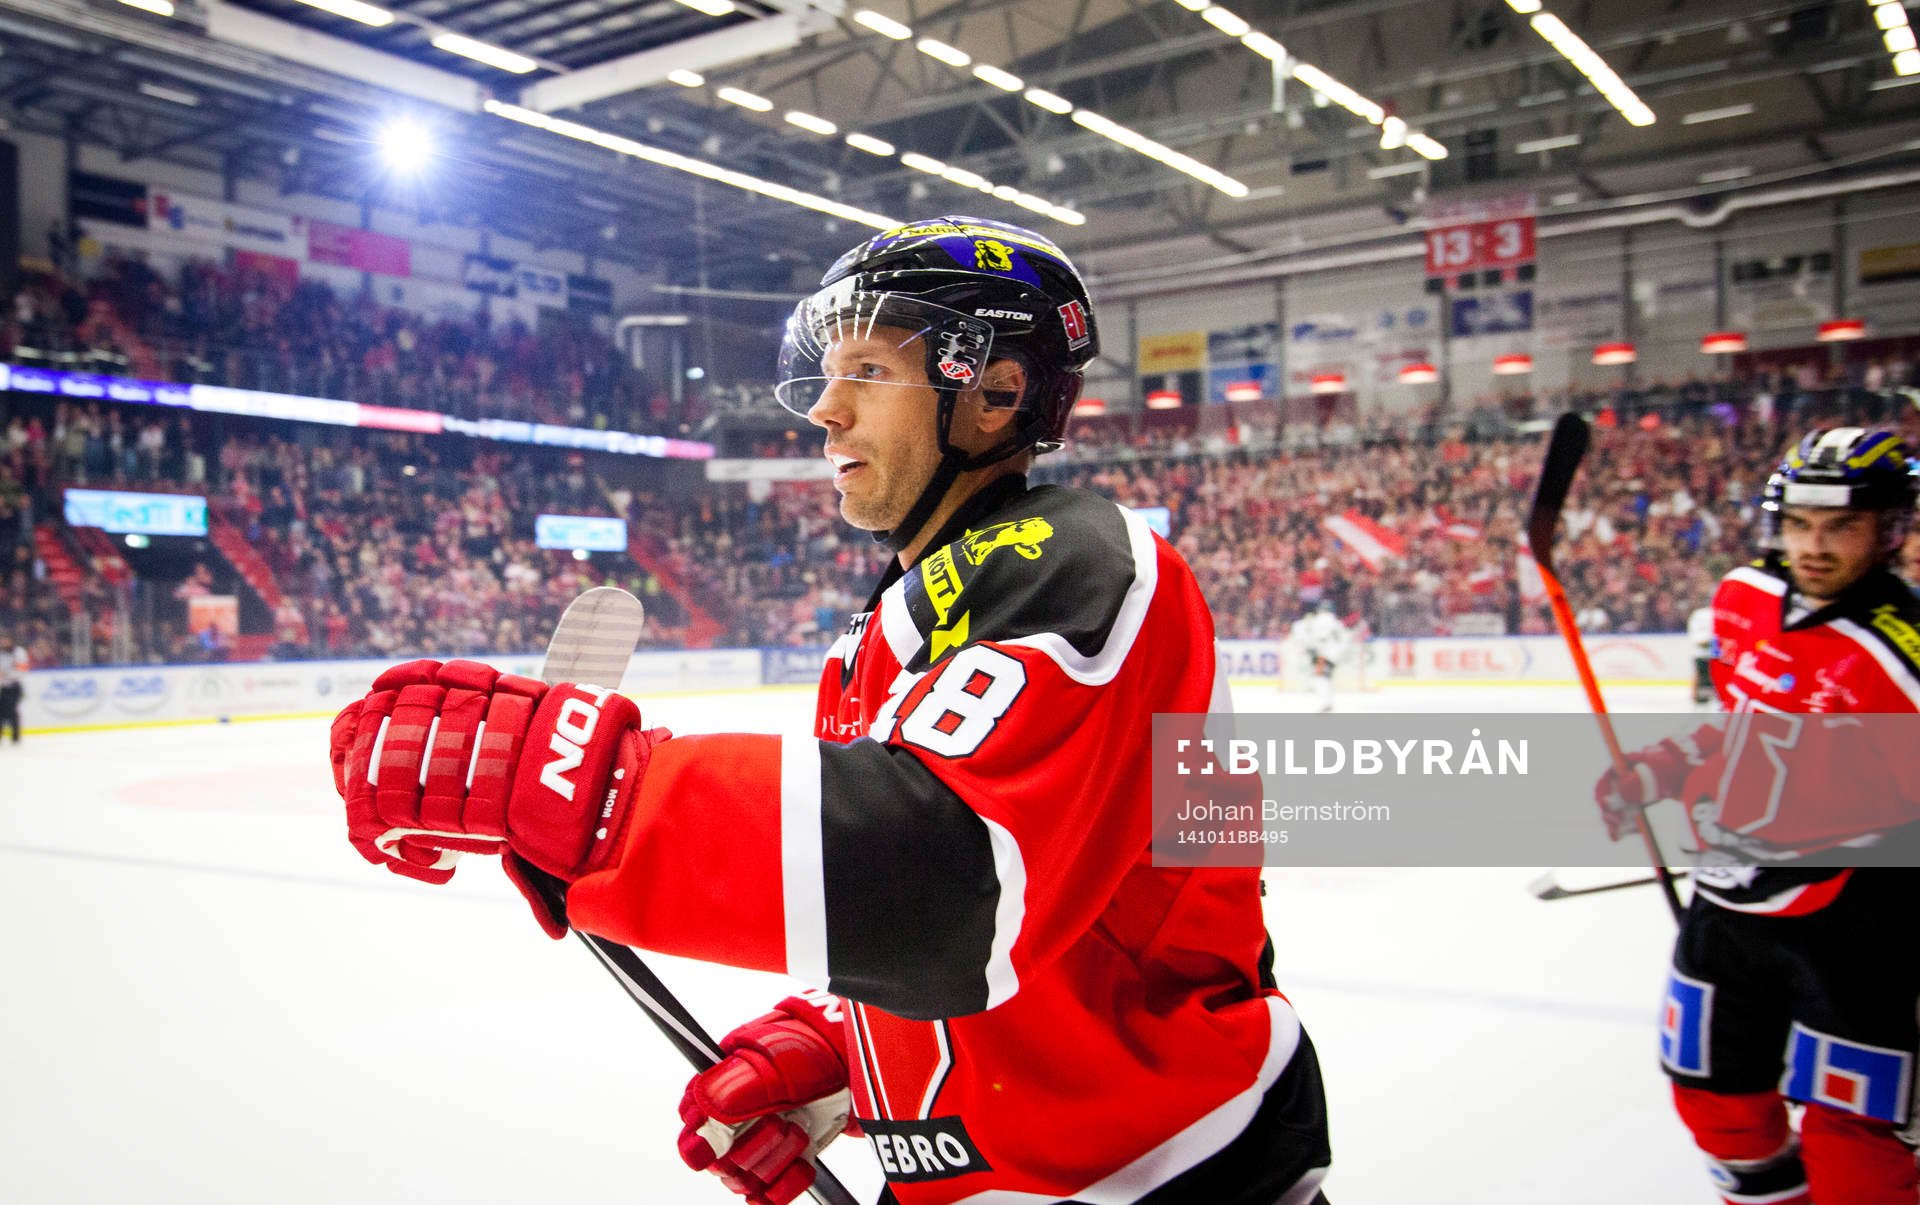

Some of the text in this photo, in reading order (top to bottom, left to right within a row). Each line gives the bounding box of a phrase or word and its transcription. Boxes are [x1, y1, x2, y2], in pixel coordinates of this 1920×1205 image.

[1431, 230, 1471, 267] 13
[974, 308, 1033, 321] EASTON
[868, 644, 1027, 759] 18
[602, 788, 618, 818] MOM
